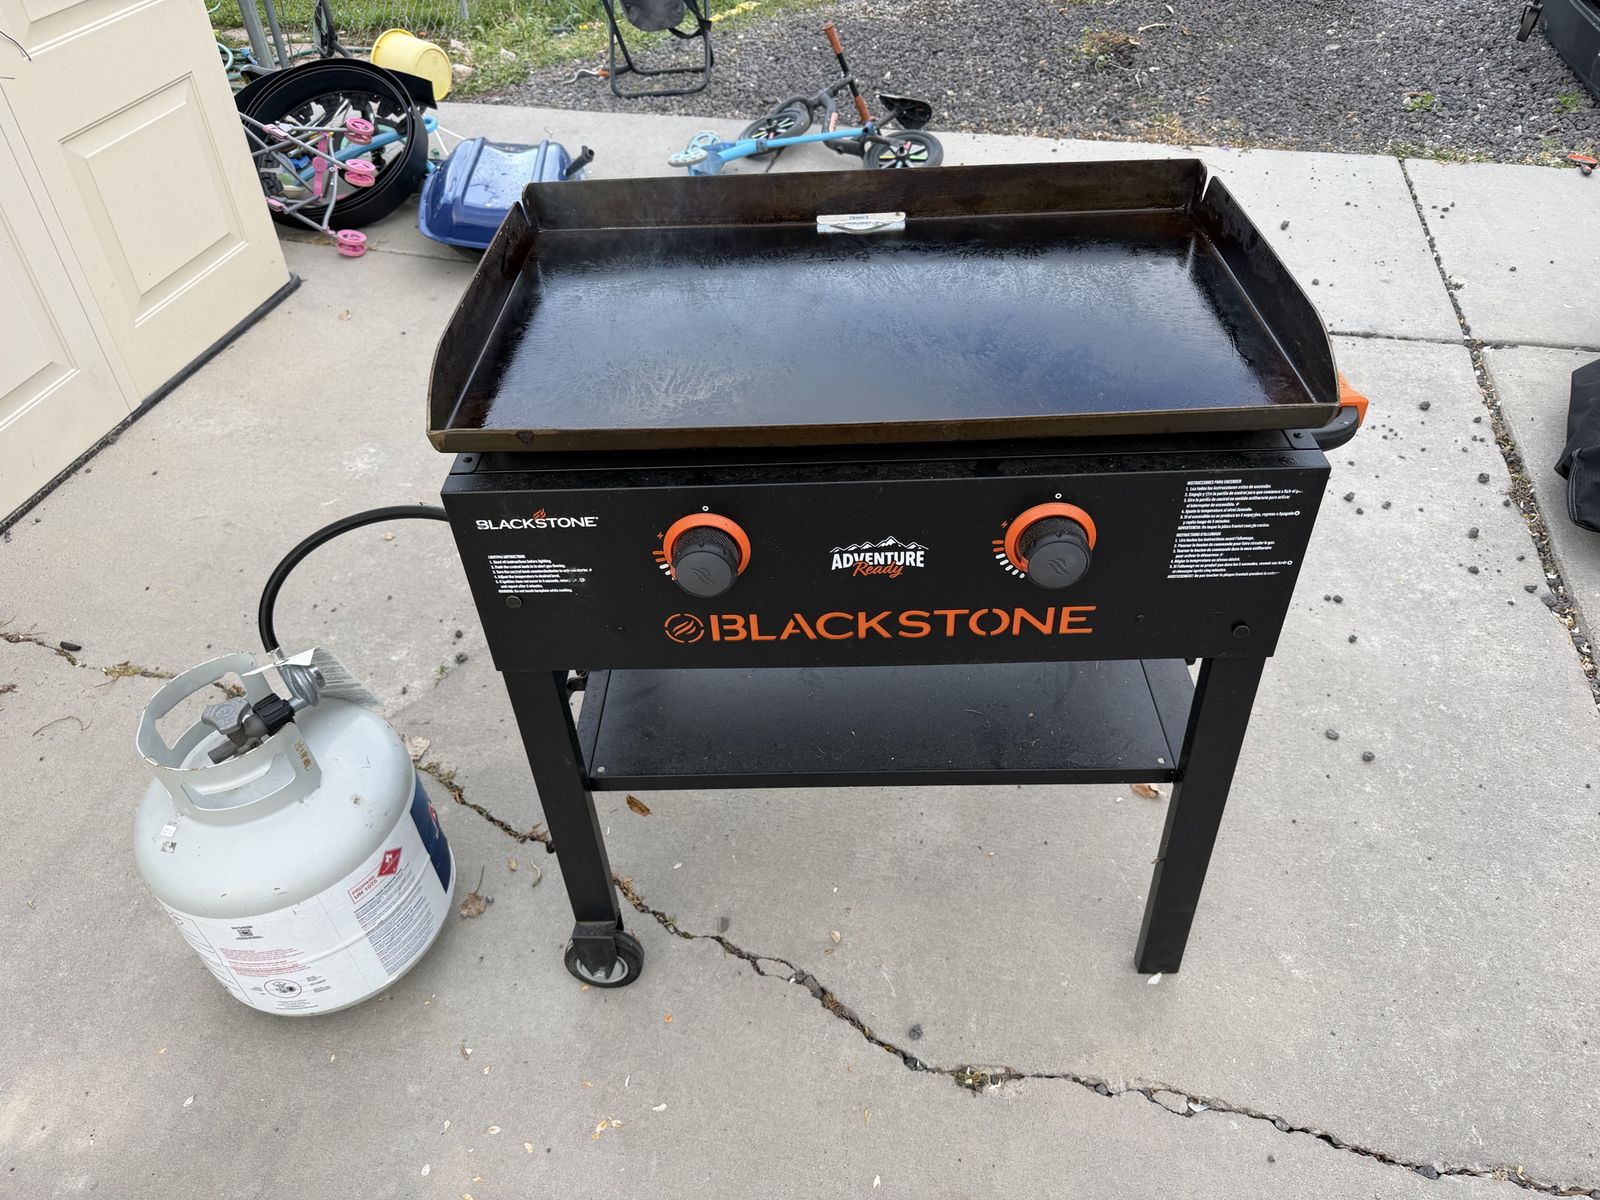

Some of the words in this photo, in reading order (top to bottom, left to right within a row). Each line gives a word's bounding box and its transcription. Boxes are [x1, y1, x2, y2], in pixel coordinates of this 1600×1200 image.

[476, 516, 597, 530] BLACKSTONE
[831, 550, 925, 571] ADVENTURE
[852, 560, 904, 578] Ready
[708, 605, 1097, 642] BLACKSTONE
